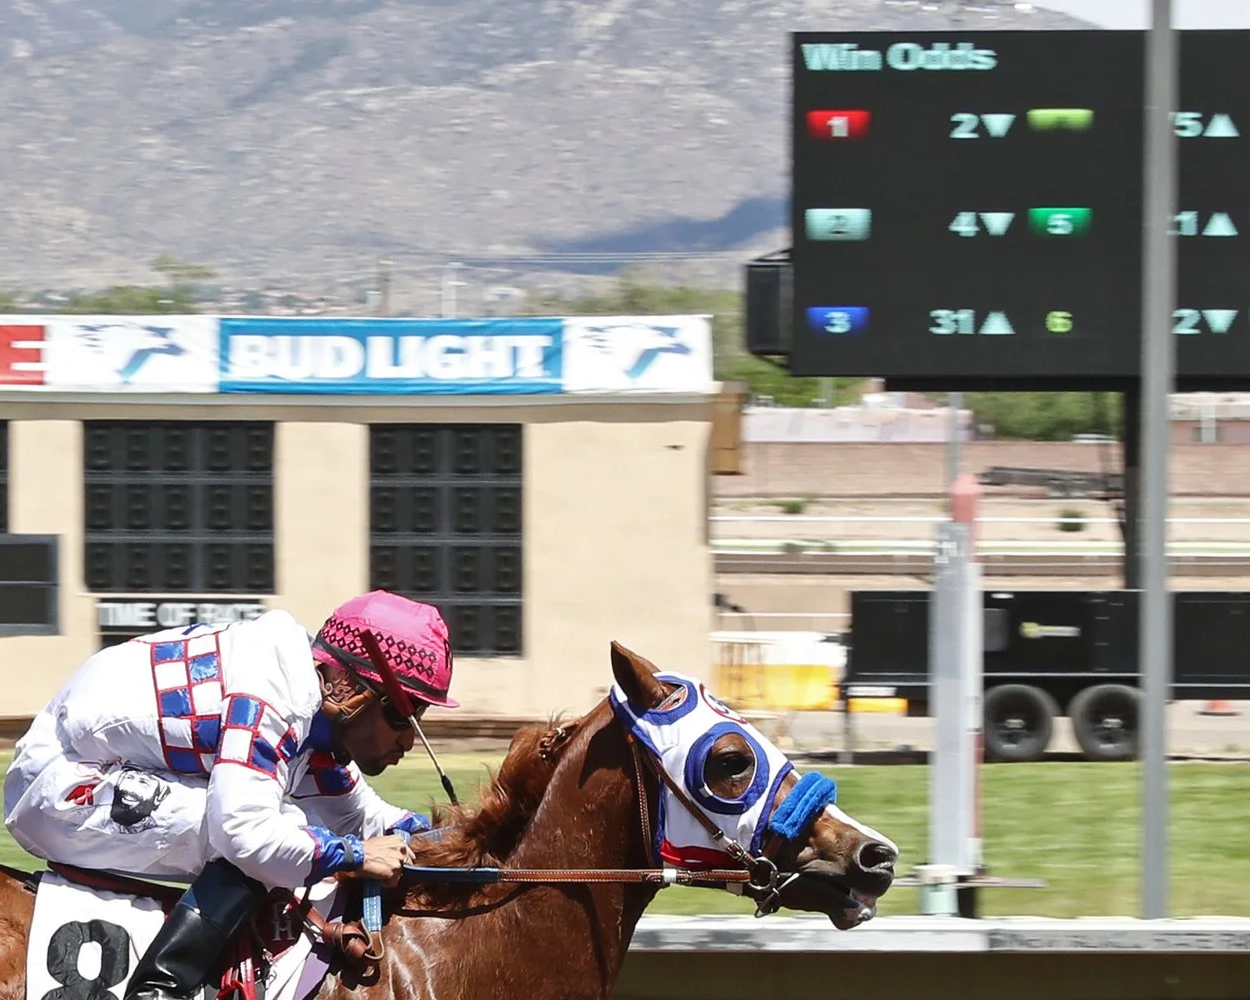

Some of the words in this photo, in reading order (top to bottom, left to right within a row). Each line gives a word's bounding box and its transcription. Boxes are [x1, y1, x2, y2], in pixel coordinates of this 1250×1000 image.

[800, 43, 883, 70] Win
[886, 42, 998, 70] Odds
[826, 116, 849, 137] 1
[950, 113, 980, 138] 2
[948, 212, 980, 237] 4
[1047, 214, 1073, 234] 5
[824, 311, 851, 333] 3
[929, 309, 975, 334] 31
[1046, 311, 1073, 332] 6
[1171, 309, 1201, 334] 2
[229, 334, 365, 379] BUD
[365, 335, 553, 379] LIGHT
